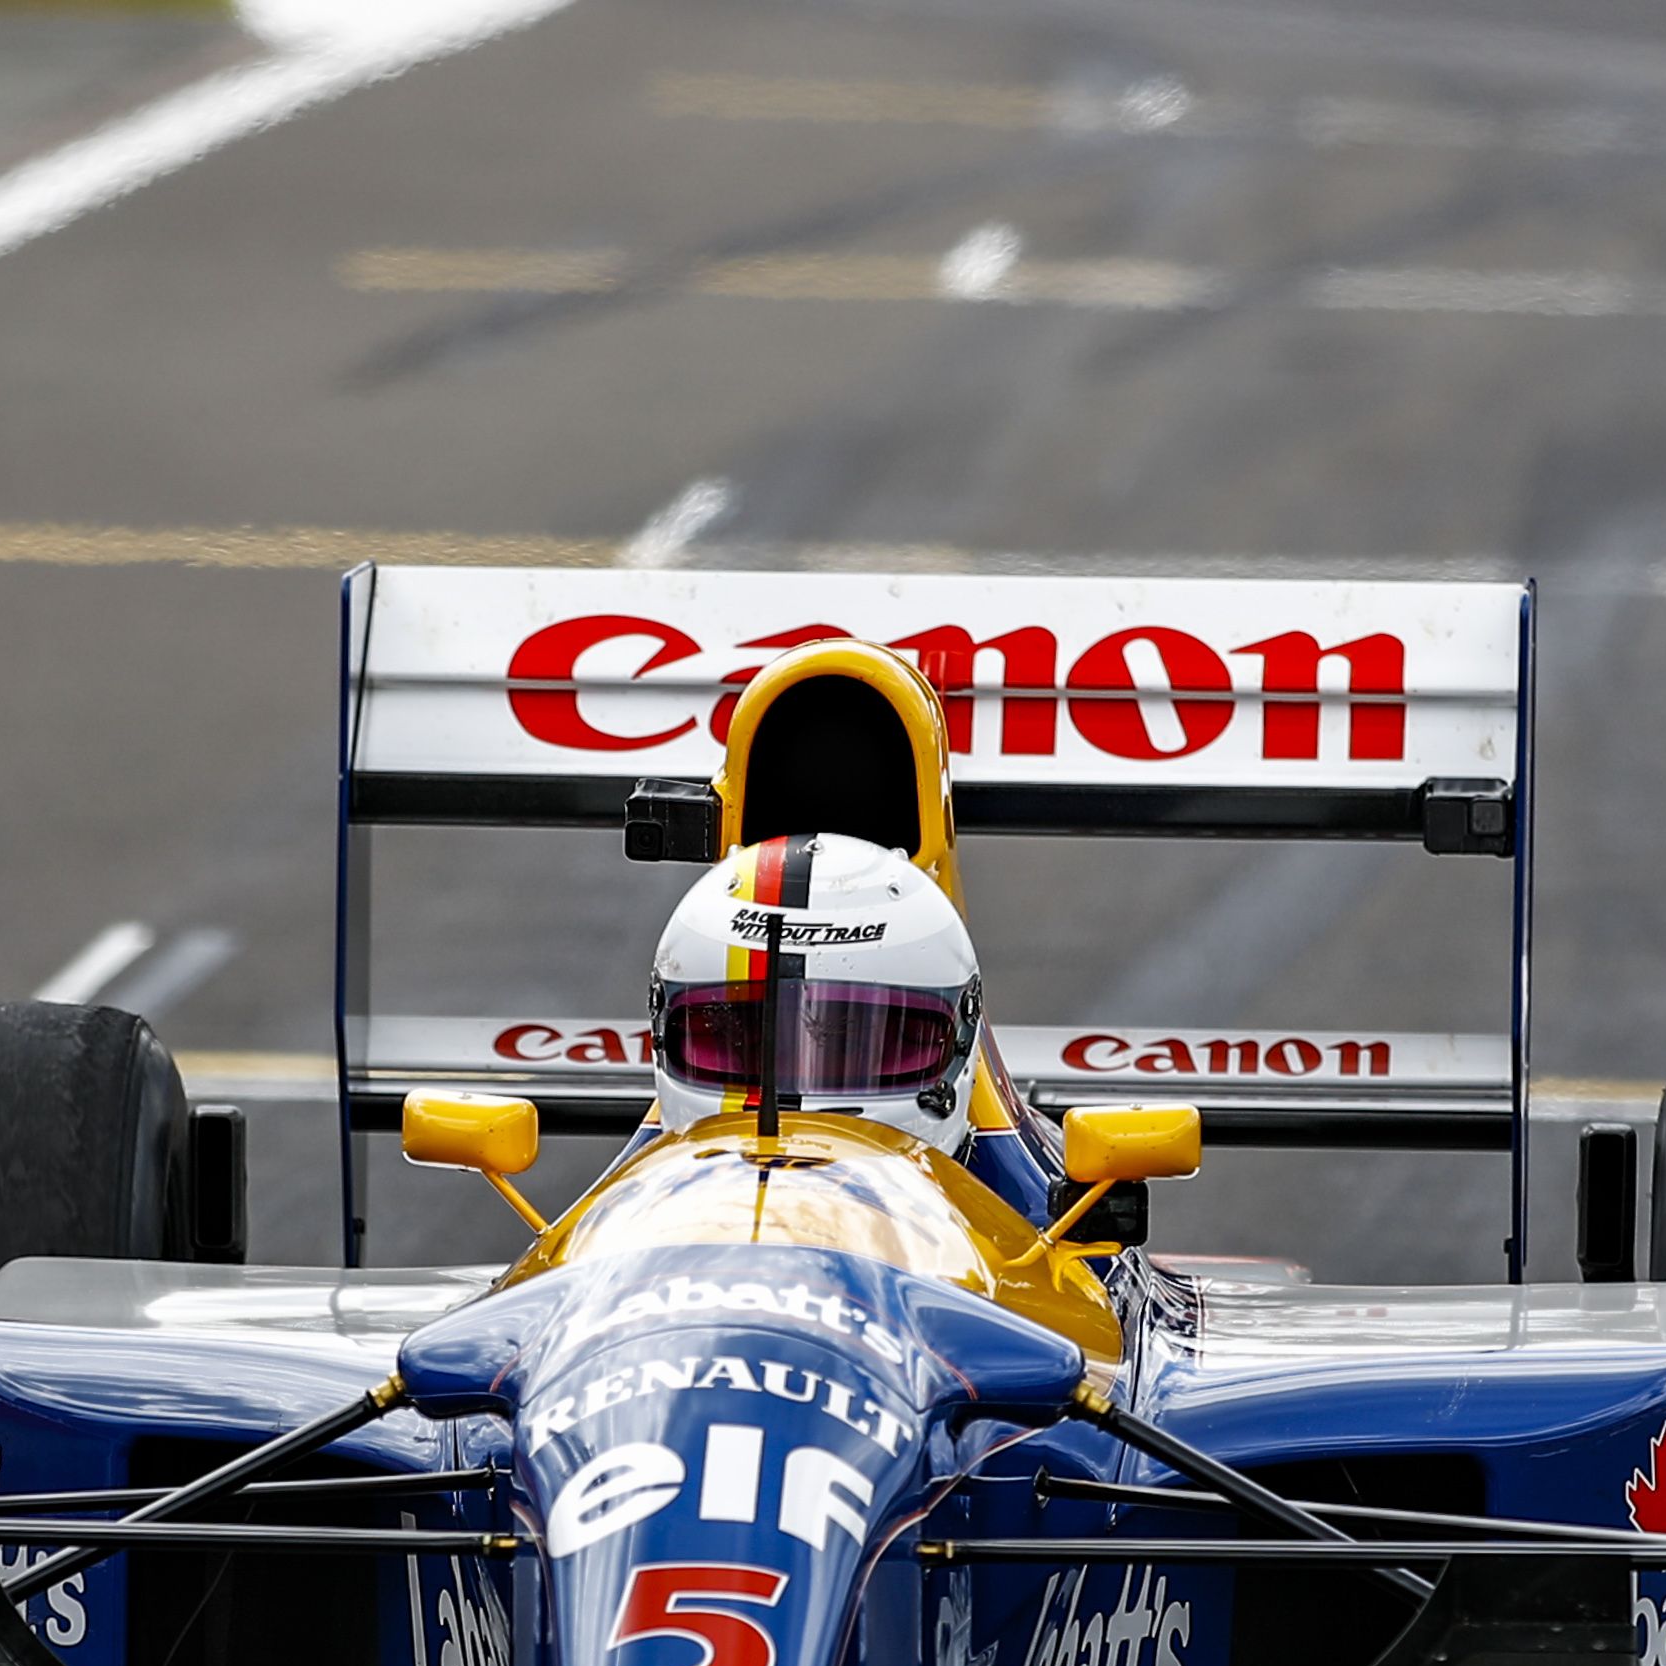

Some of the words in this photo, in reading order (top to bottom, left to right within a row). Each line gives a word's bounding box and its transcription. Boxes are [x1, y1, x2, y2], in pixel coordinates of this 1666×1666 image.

[823, 923, 887, 941] TRACE
[1061, 1034, 1391, 1077] Canon
[560, 1276, 904, 1366] Labatt's
[528, 1356, 914, 1459] RENAULT
[548, 1424, 874, 1559] elf
